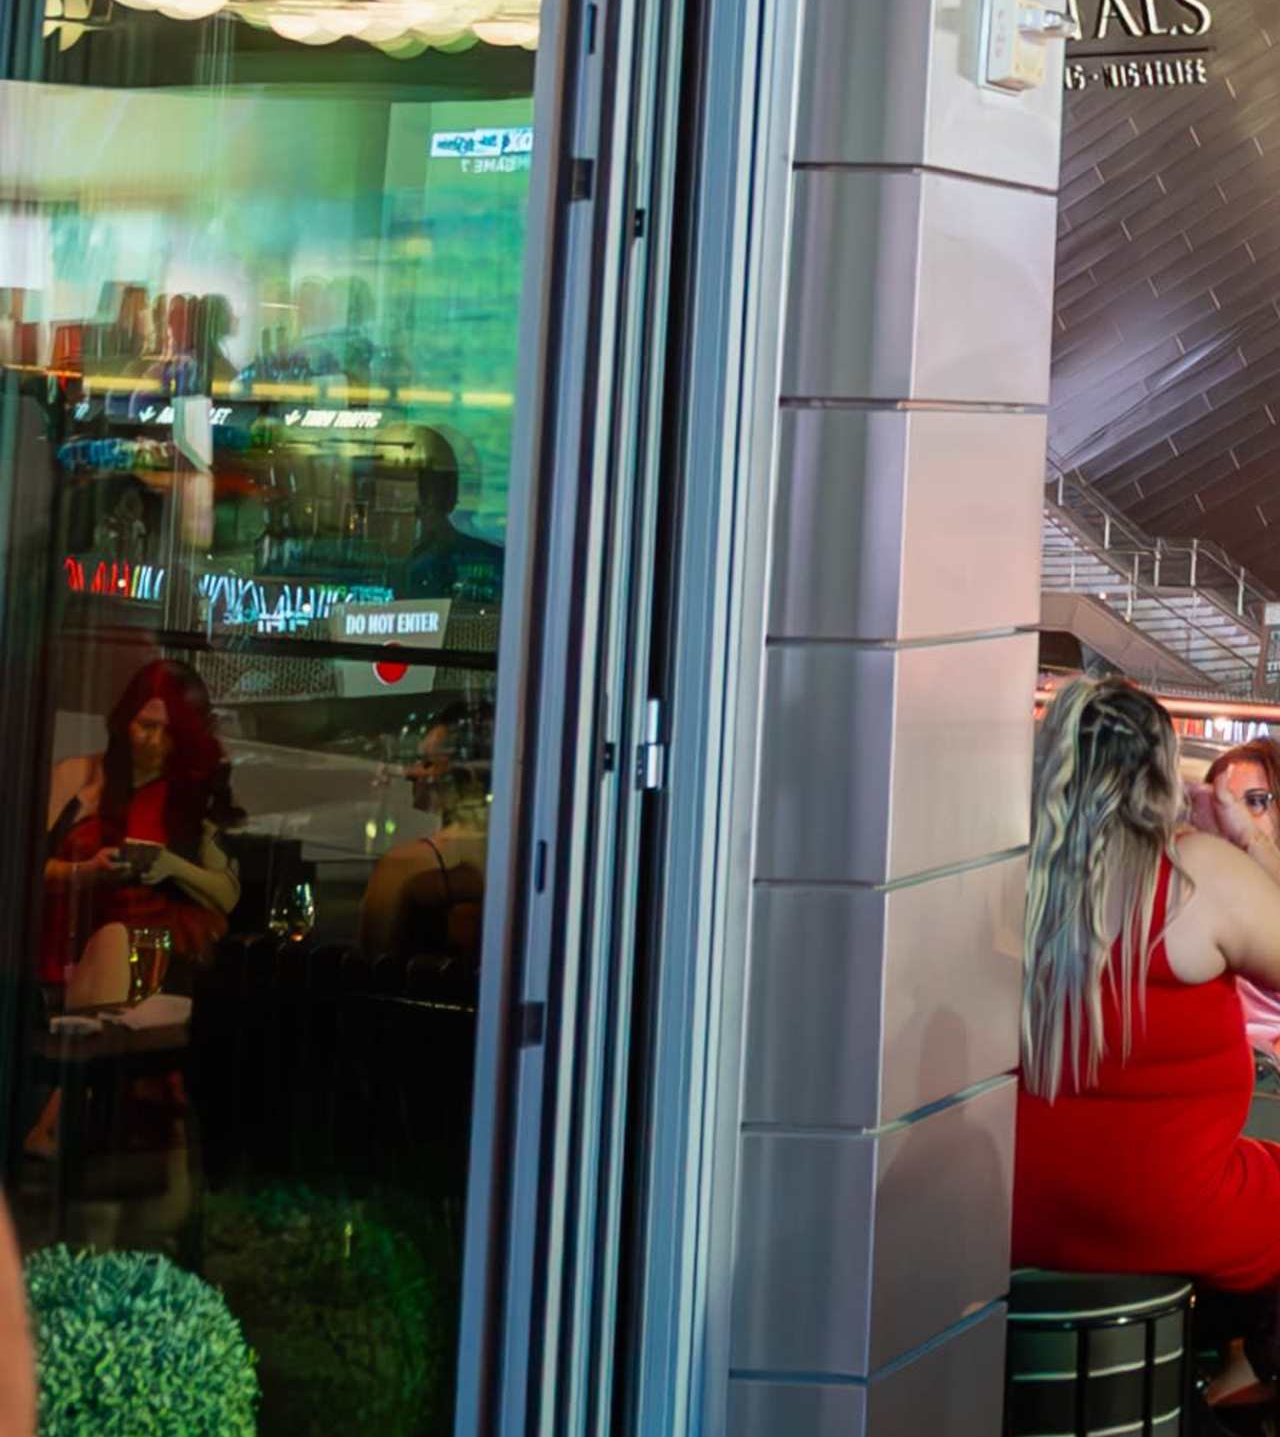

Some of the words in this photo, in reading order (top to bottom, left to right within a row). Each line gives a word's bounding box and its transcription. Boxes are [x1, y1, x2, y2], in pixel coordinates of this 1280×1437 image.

[345, 614, 366, 635] DO
[368, 613, 394, 635] NOT
[397, 611, 440, 634] ENTER
